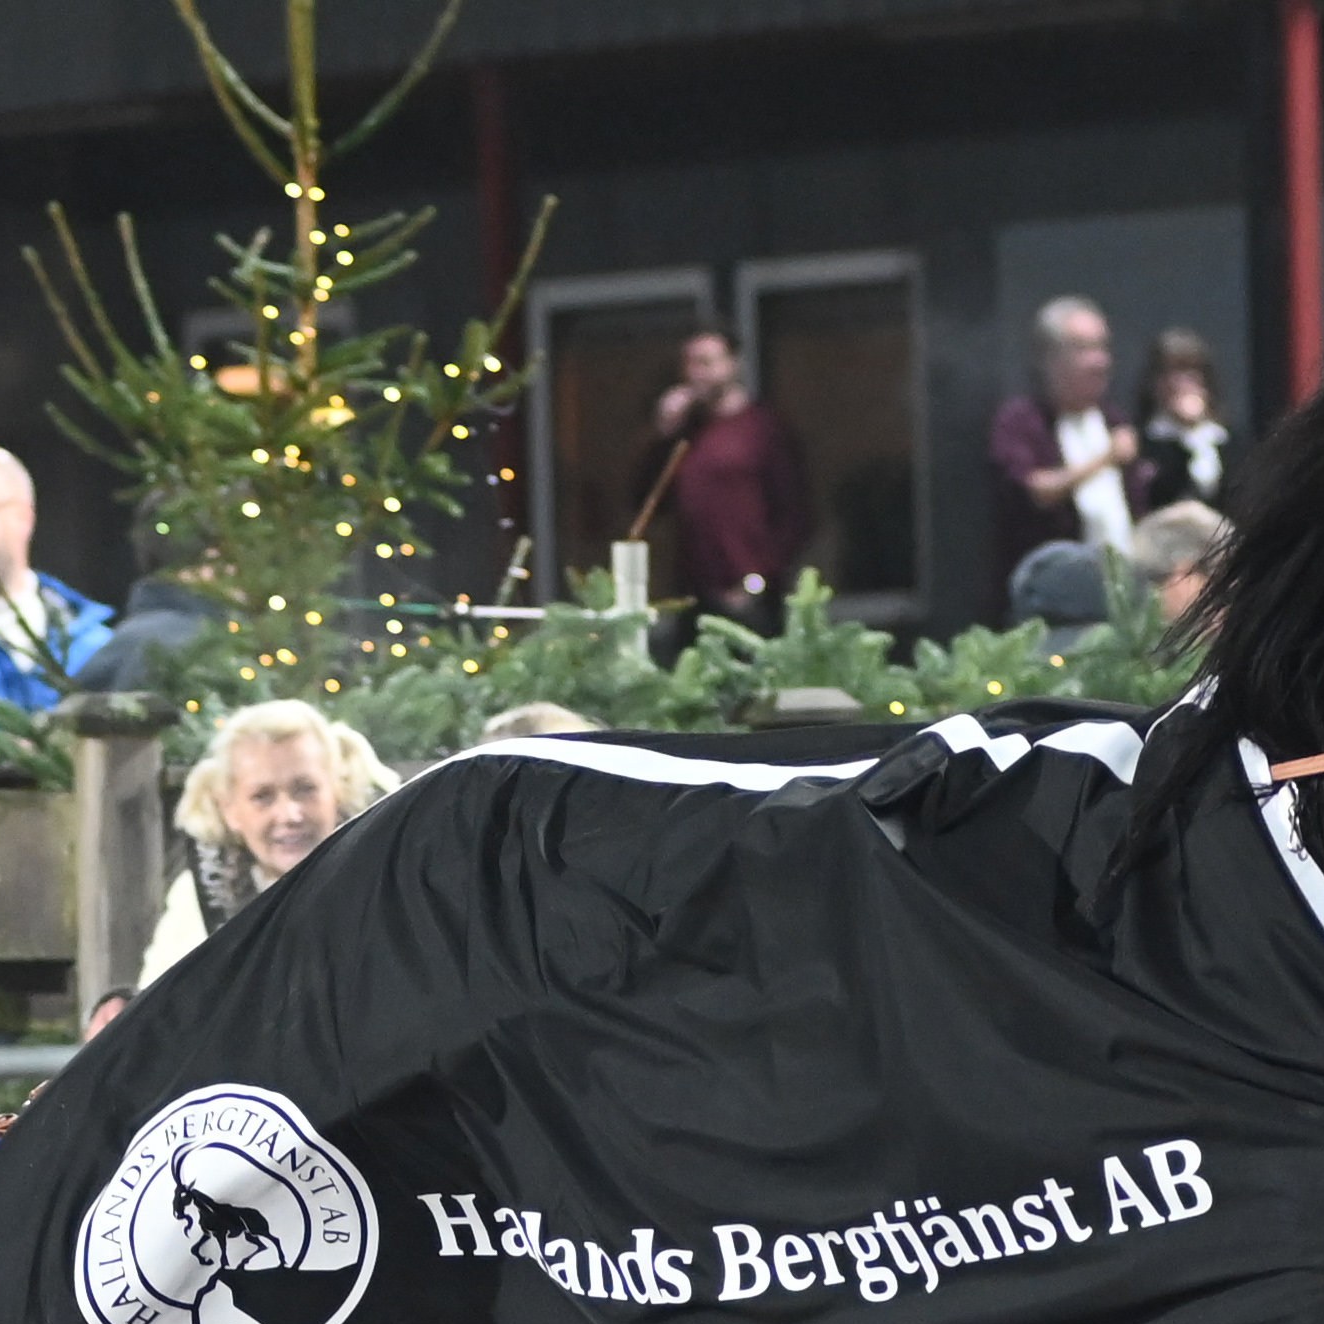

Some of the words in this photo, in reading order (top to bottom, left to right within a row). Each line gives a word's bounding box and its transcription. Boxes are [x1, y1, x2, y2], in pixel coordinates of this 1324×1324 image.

[164, 1106, 339, 1195] BERGTJÄNST
[319, 1205, 351, 1245] AB
[712, 1177, 1093, 1303] Bergtjänst
[1104, 1139, 1213, 1235] AB
